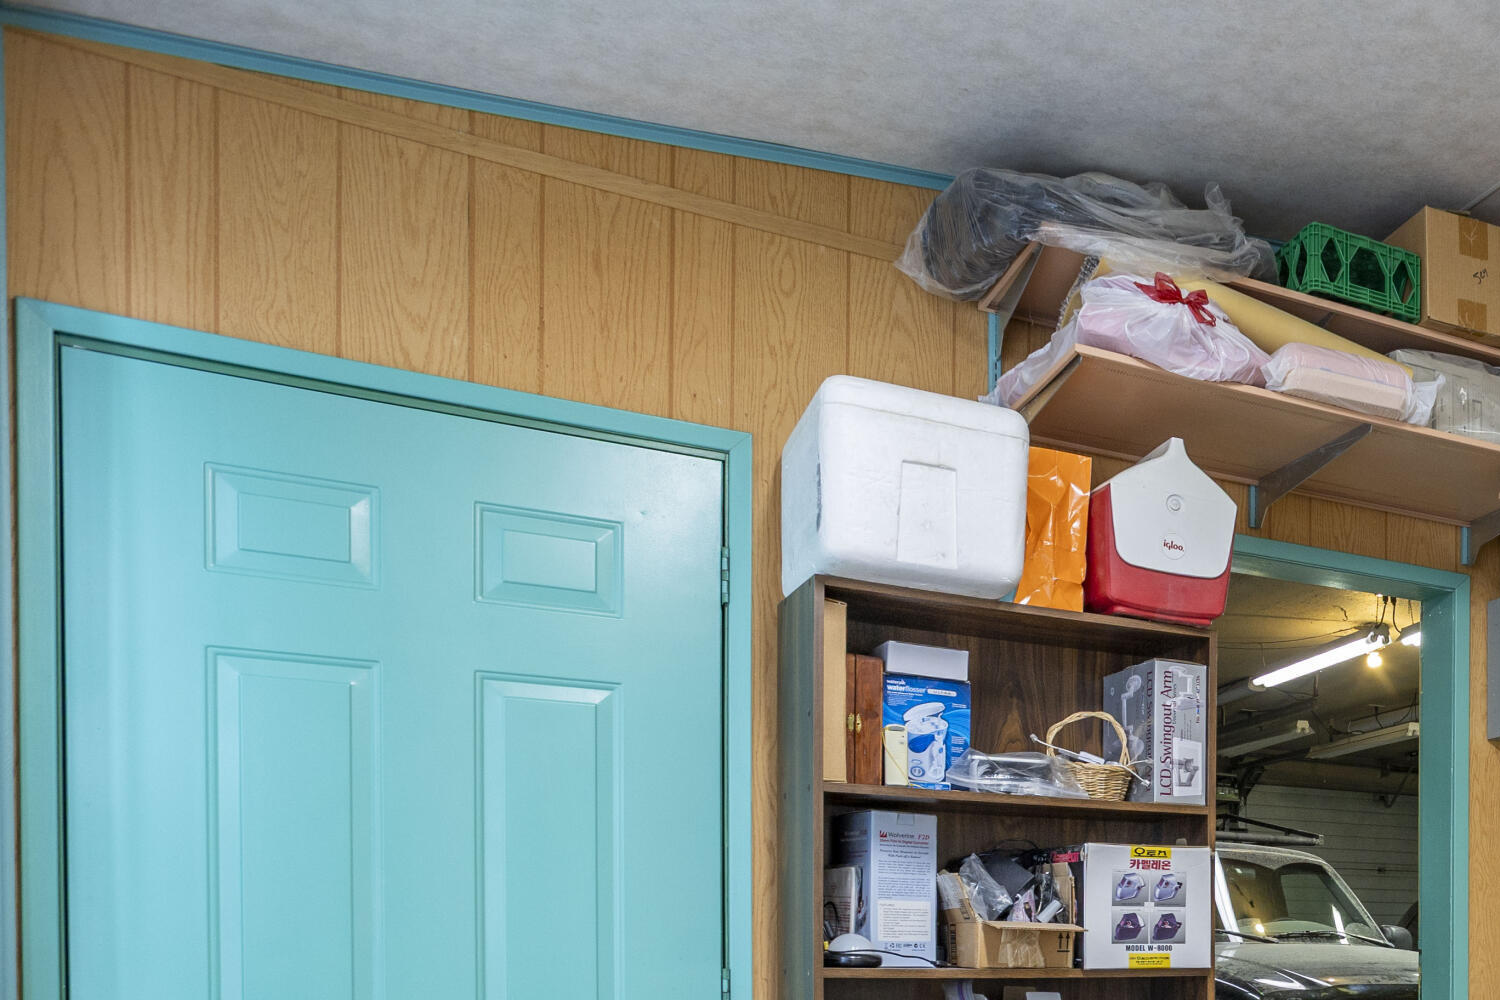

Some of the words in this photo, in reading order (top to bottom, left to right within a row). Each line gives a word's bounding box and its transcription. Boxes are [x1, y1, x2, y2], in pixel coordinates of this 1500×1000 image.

[1163, 539, 1184, 551] igloo
[1160, 670, 1173, 699] Arm
[1160, 703, 1175, 765] Swingout
[1160, 768, 1173, 796] LCD
[1129, 859, 1172, 870] 카멜레온
